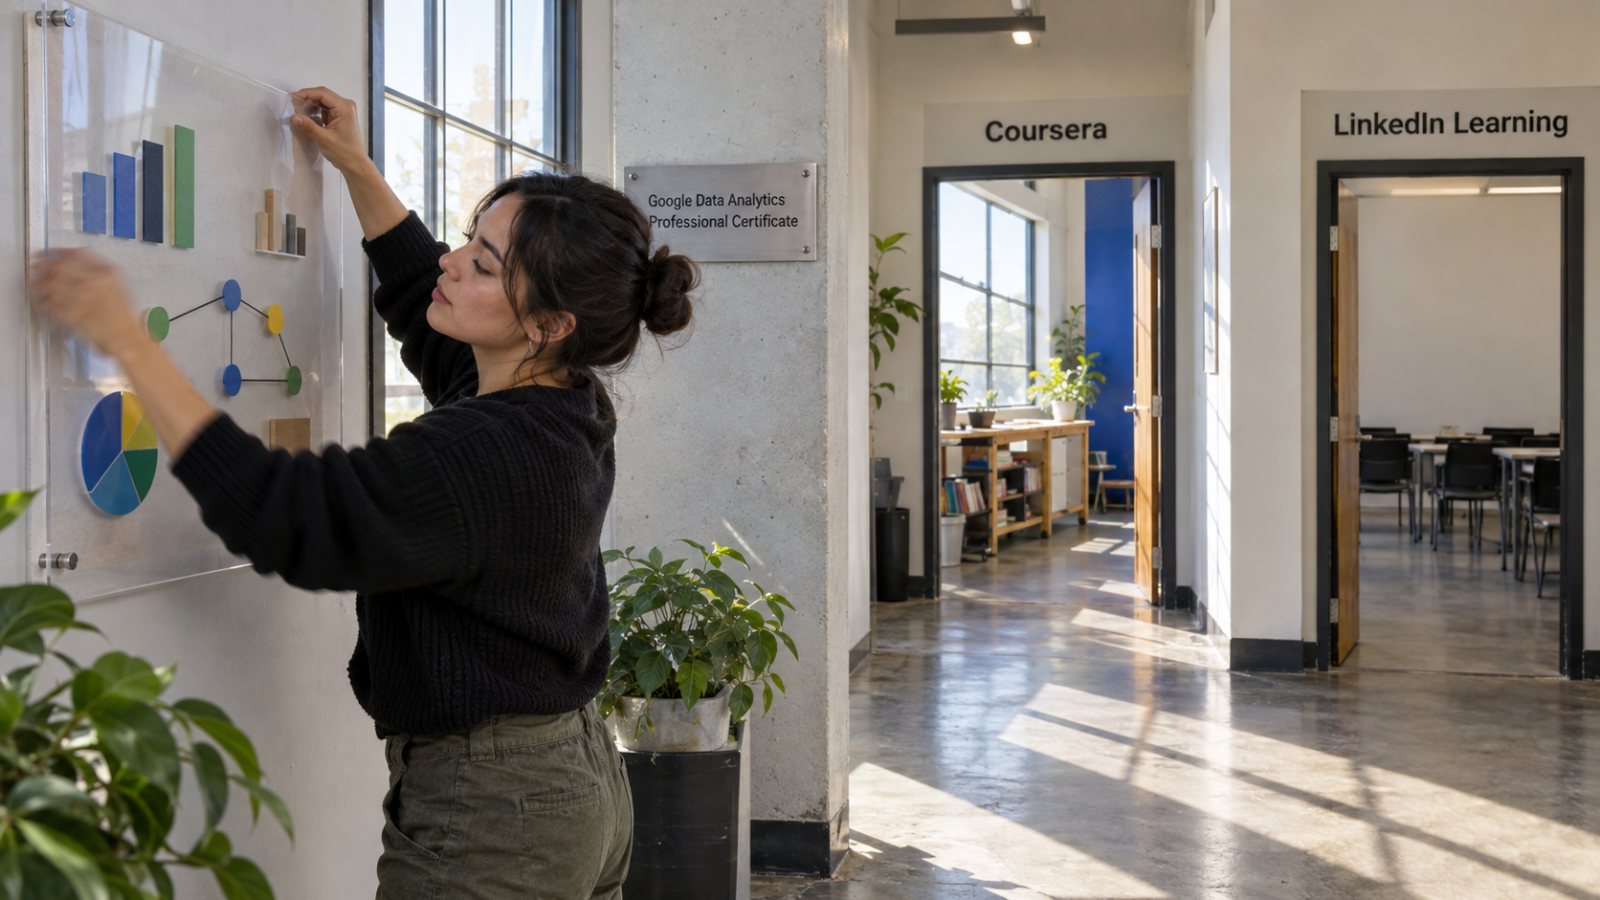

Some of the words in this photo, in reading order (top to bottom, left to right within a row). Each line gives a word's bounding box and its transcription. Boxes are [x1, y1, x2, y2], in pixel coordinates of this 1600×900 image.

[985, 120, 1107, 142] Coursera
[1334, 112, 1444, 136] LinkedIn
[1454, 109, 1568, 138] Learning
[648, 194, 692, 210] Google
[695, 194, 724, 207] Data
[728, 193, 786, 209] Analytics
[649, 214, 728, 228] Professional
[732, 213, 799, 228] Certificate
